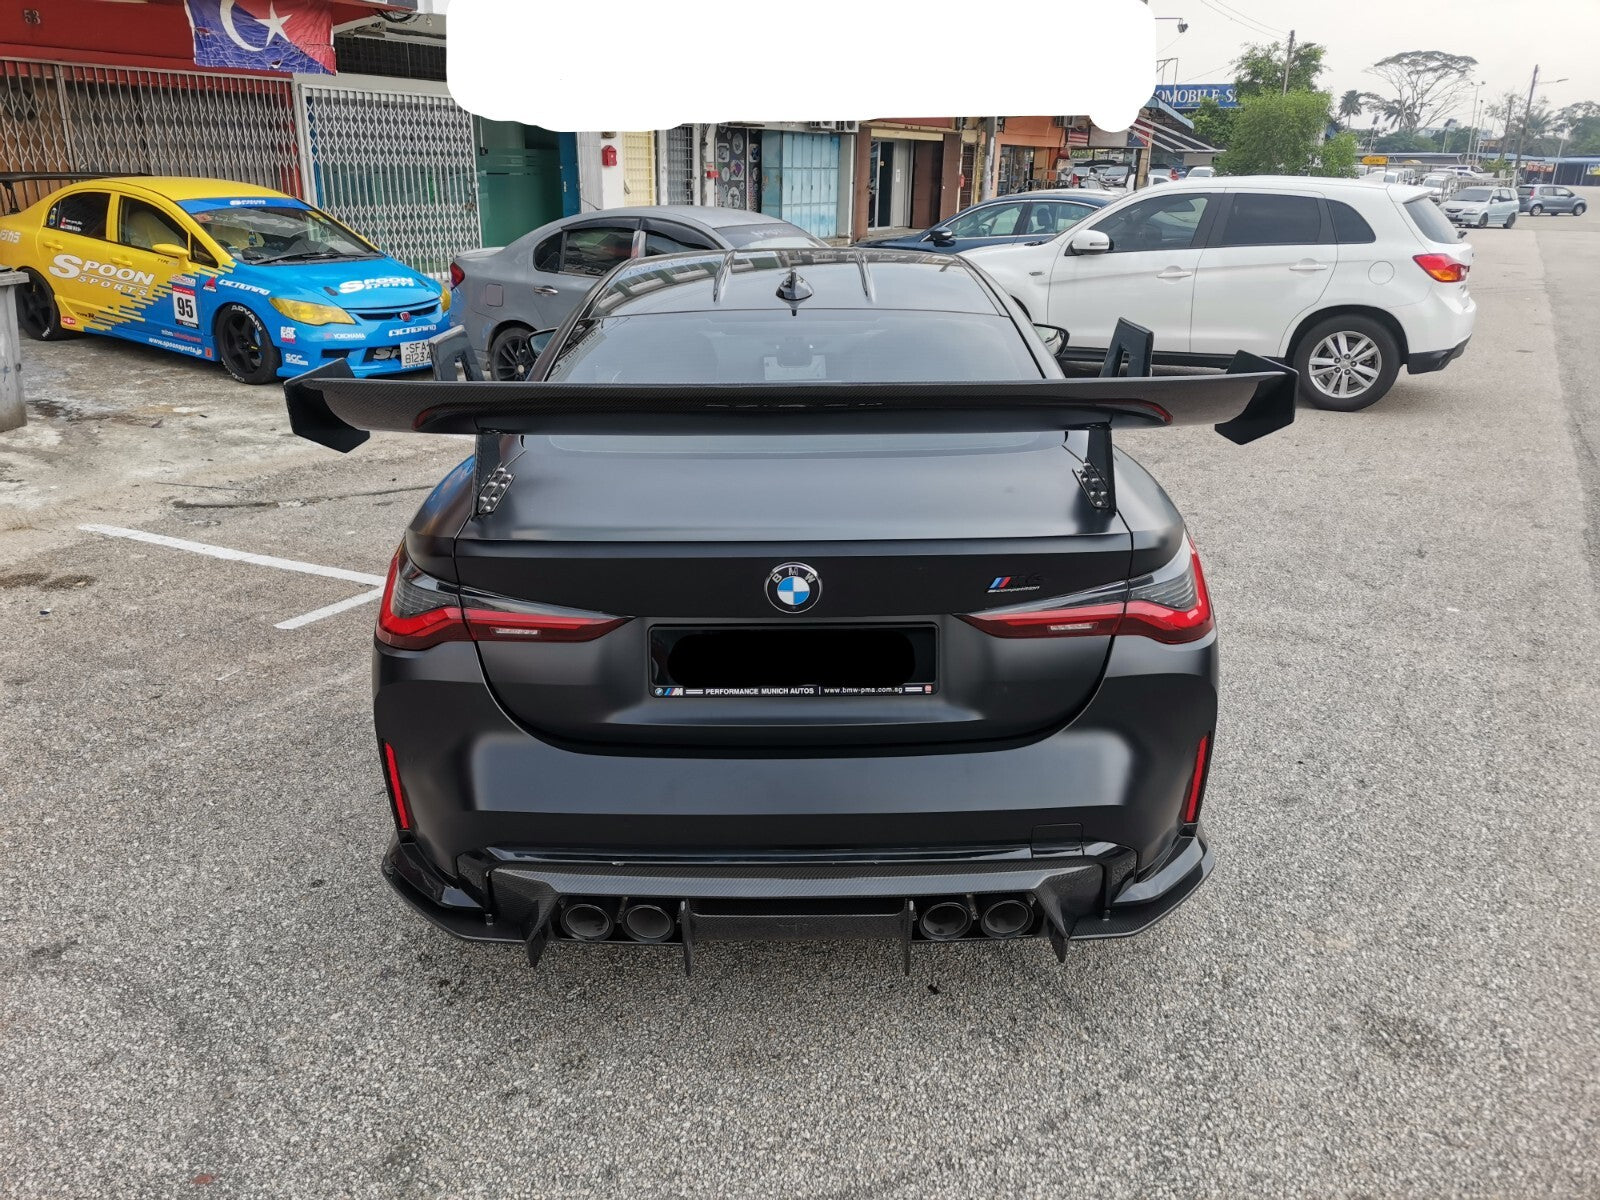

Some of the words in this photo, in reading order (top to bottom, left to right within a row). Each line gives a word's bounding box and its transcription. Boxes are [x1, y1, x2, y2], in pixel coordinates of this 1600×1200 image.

[48, 254, 155, 286] SPOON
[77, 274, 149, 296] SPORTS
[338, 277, 415, 294] SPOON
[176, 296, 194, 319] 95
[332, 332, 366, 340] YOKOHAMA
[771, 566, 816, 584] BMW
[823, 686, 903, 694] www.bmw-pma.com.sg
